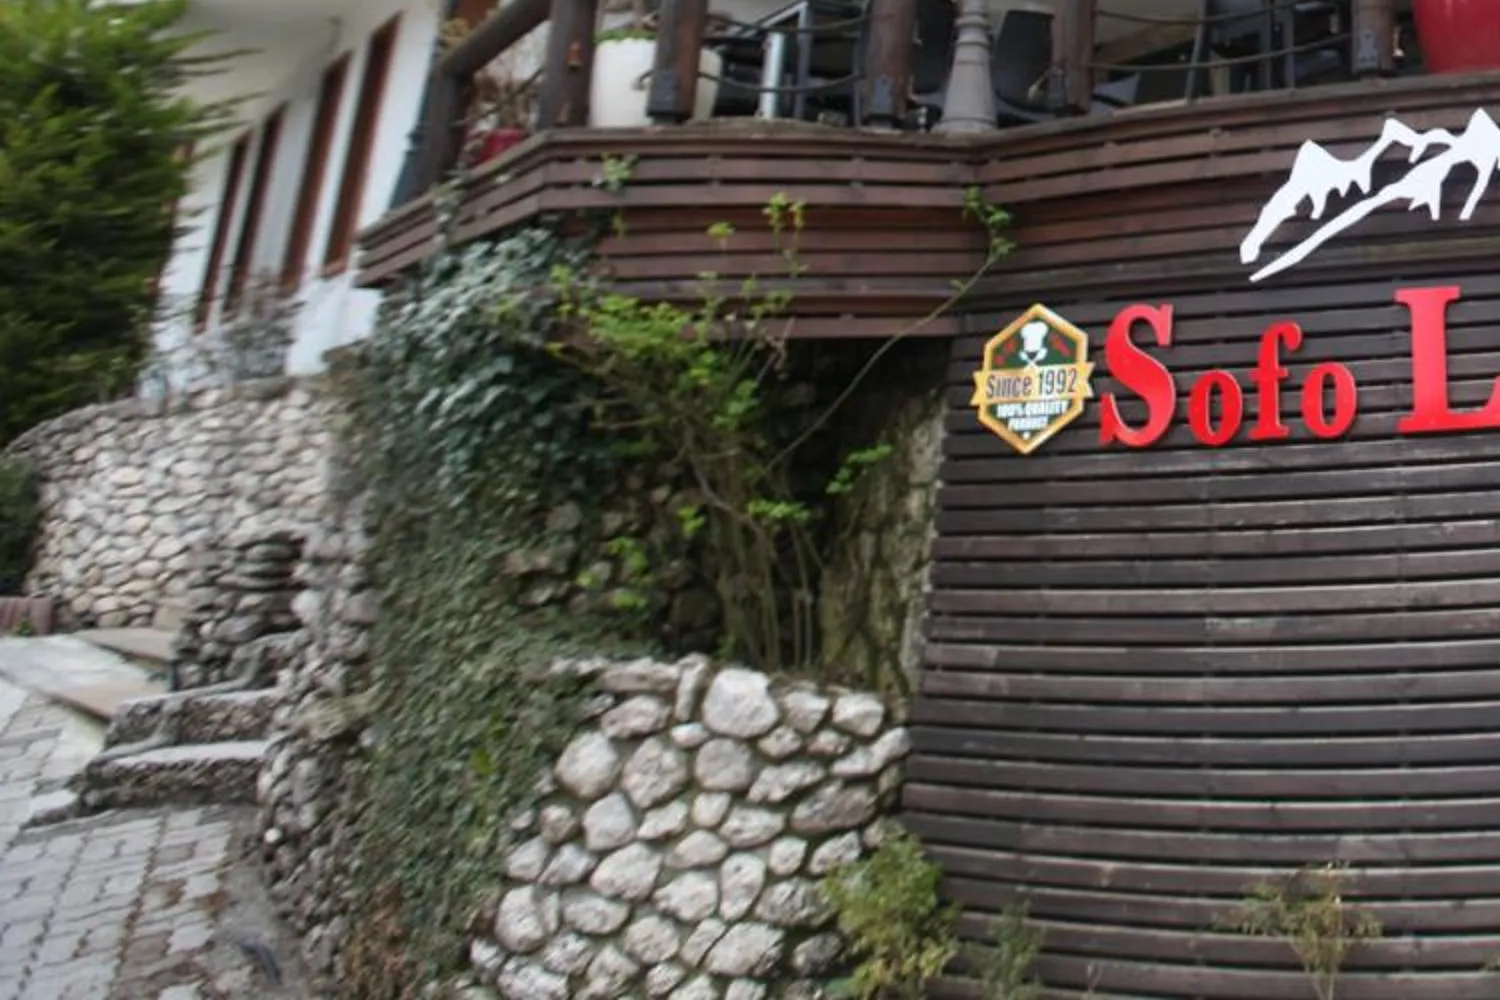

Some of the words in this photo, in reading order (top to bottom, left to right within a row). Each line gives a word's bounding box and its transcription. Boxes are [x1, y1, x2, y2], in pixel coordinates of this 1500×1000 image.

[986, 374, 1033, 399] Since
[1039, 367, 1078, 396] 1992
[1097, 303, 1358, 447] Sofo
